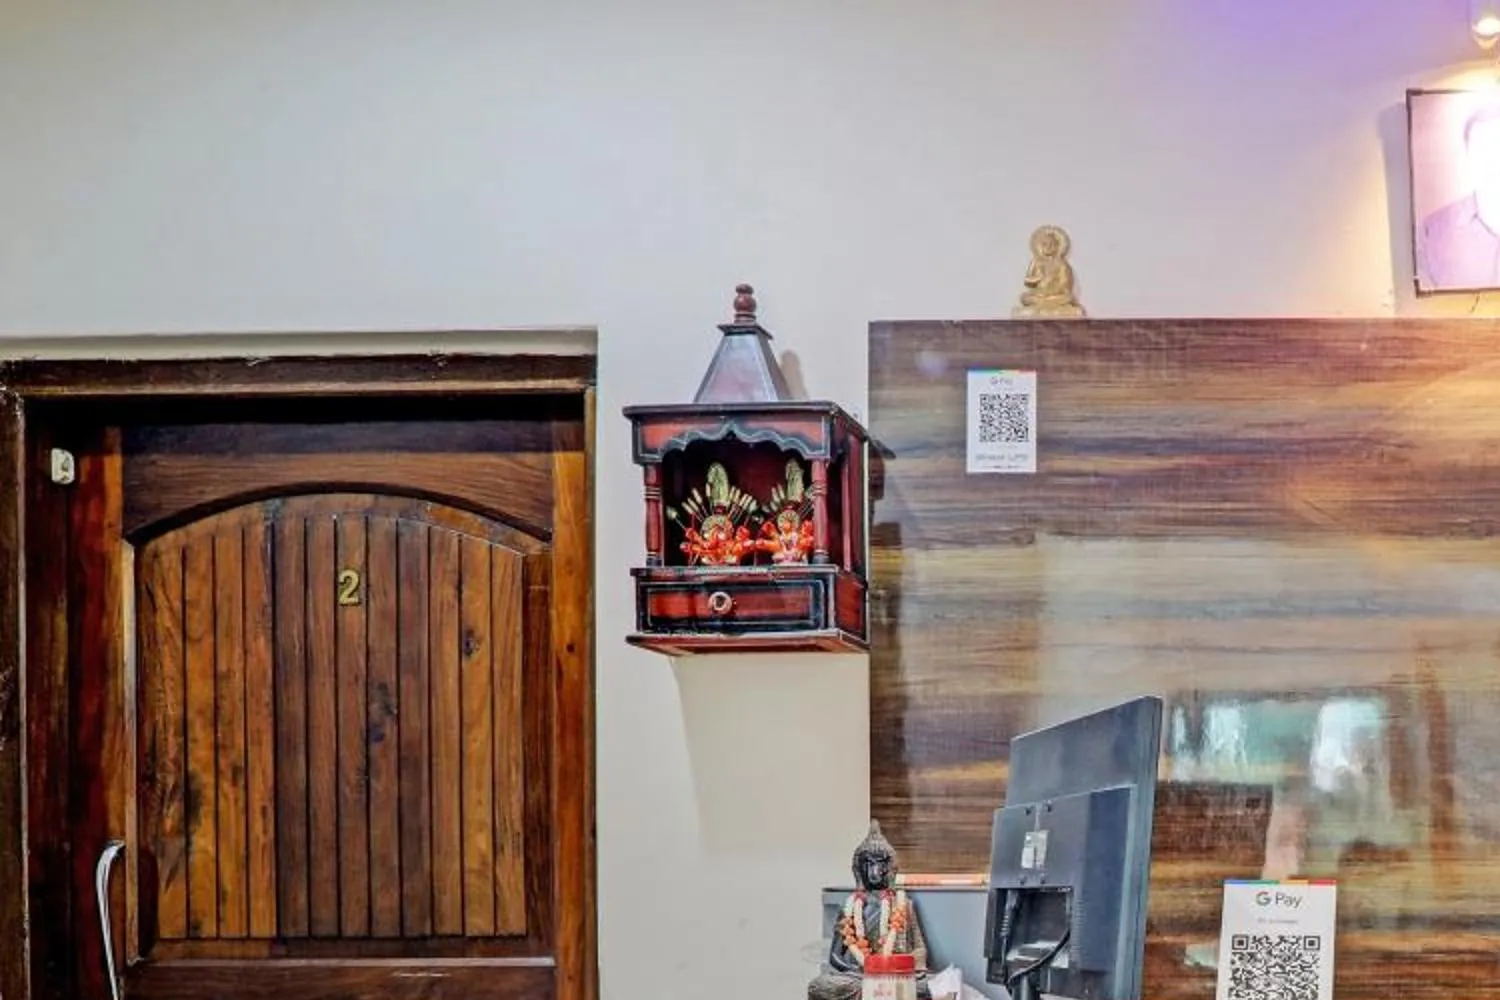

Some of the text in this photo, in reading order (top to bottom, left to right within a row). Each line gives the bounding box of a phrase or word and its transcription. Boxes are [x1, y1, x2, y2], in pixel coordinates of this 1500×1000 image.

[338, 569, 360, 605] 2
[1255, 891, 1303, 909] G Pay
